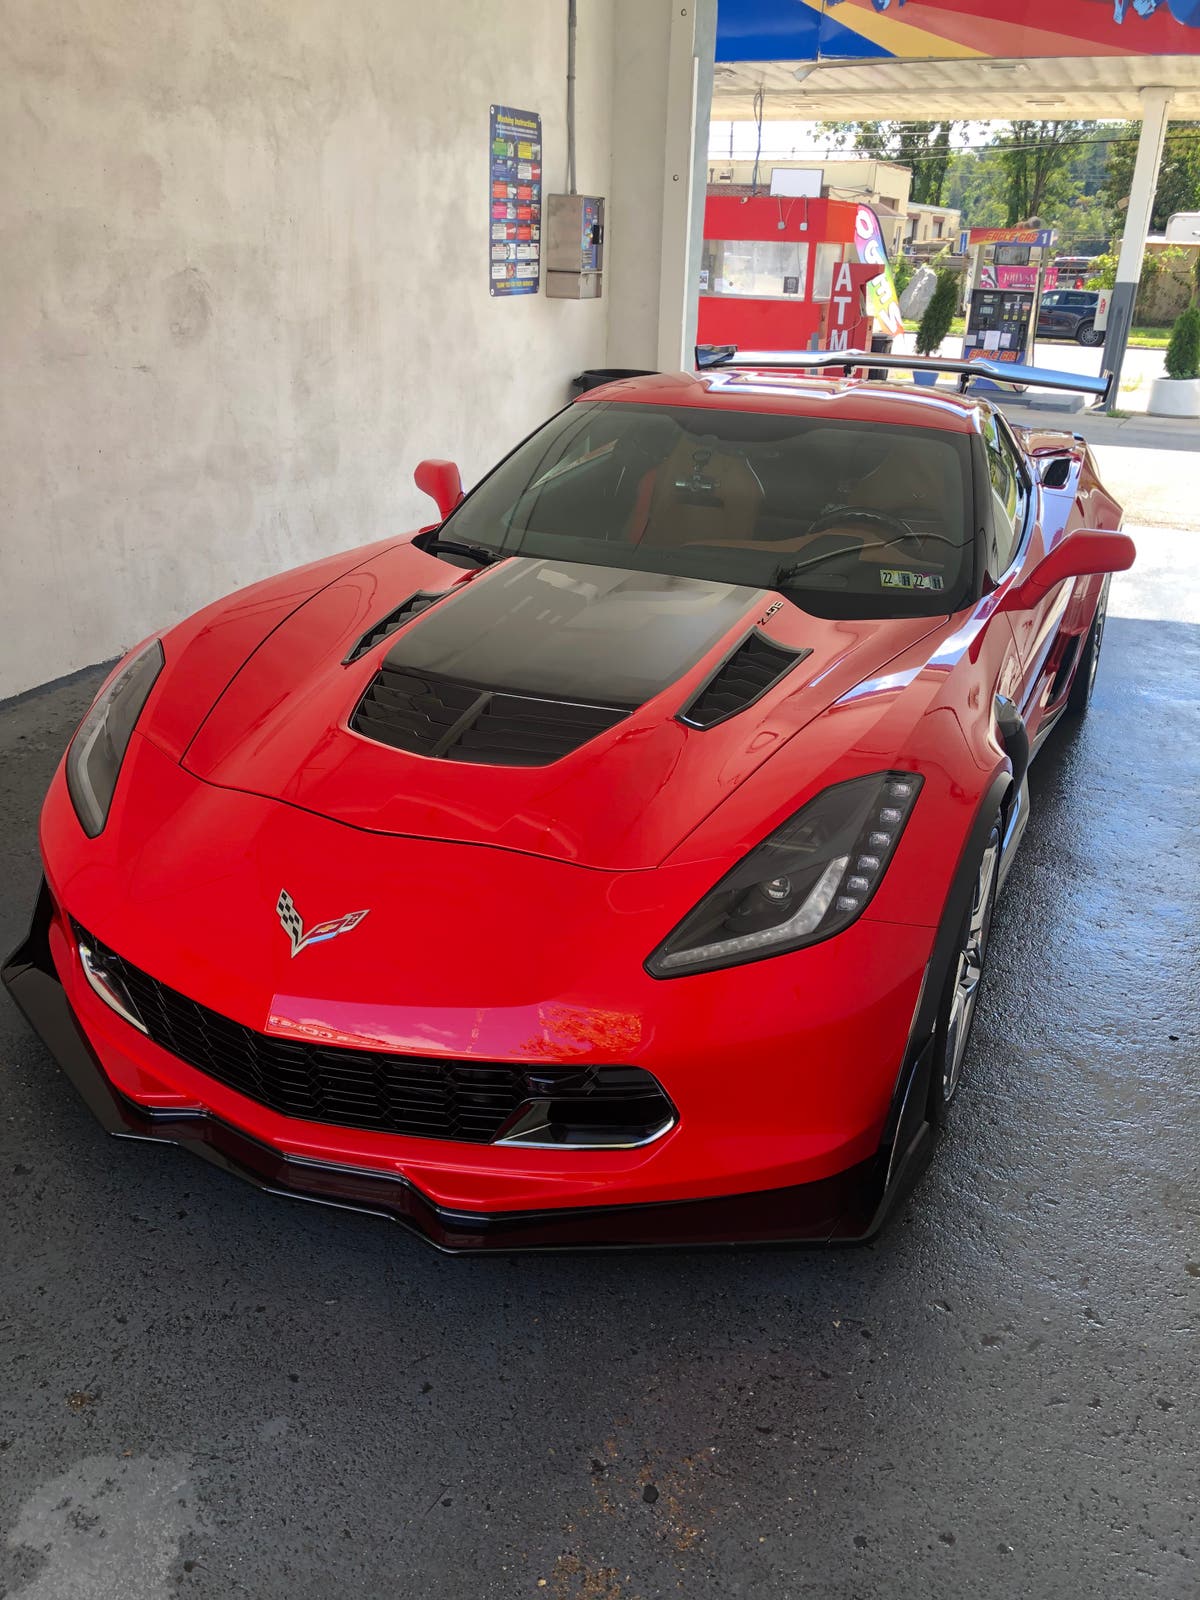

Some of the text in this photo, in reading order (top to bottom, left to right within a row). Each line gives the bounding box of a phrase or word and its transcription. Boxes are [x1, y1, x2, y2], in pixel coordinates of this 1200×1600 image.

[984, 230, 1048, 244] EAGLE GAS 1
[830, 263, 852, 350] ATM
[883, 572, 893, 584] 22
[913, 574, 925, 587] 22
